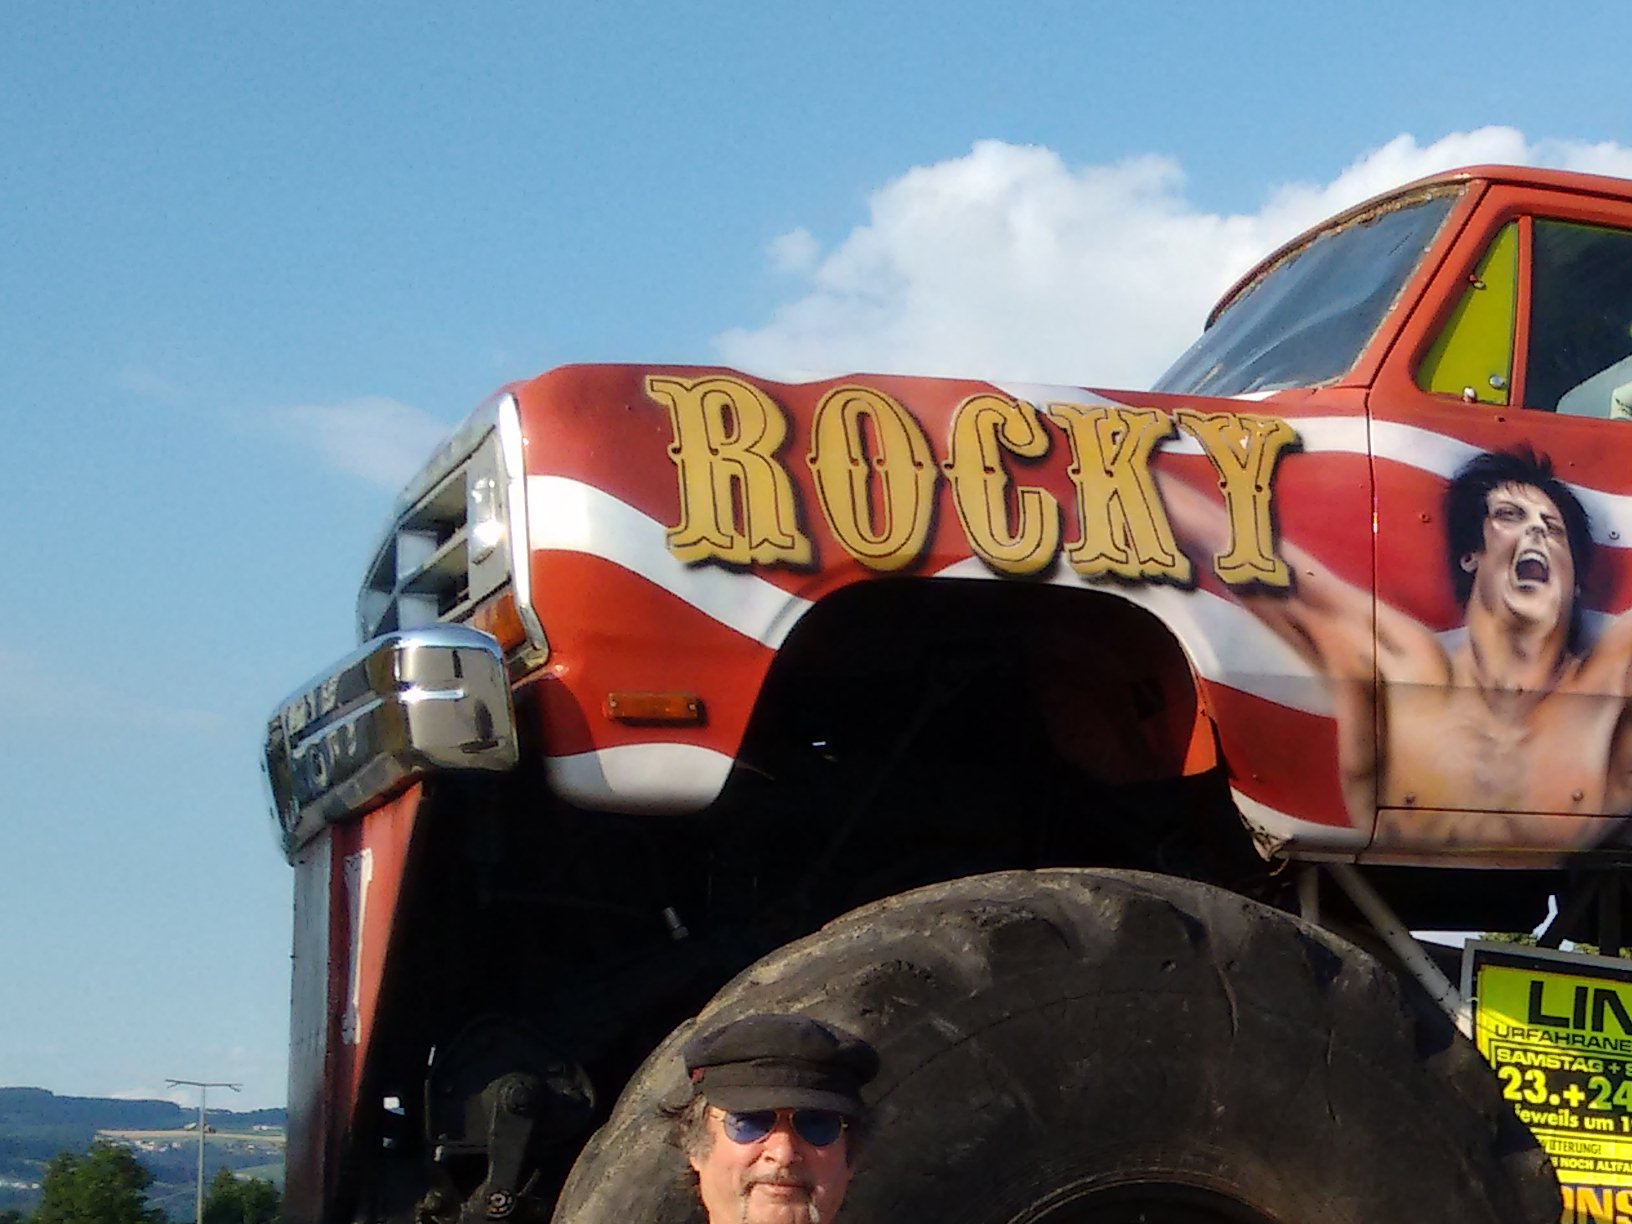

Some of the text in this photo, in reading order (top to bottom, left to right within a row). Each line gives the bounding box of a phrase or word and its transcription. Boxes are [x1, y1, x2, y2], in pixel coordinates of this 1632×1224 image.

[646, 375, 1299, 587] ROCKY
[1496, 1048, 1604, 1073] SAMSTAG
[1584, 1116, 1615, 1132] um
[1560, 1157, 1595, 1170] NOCH
